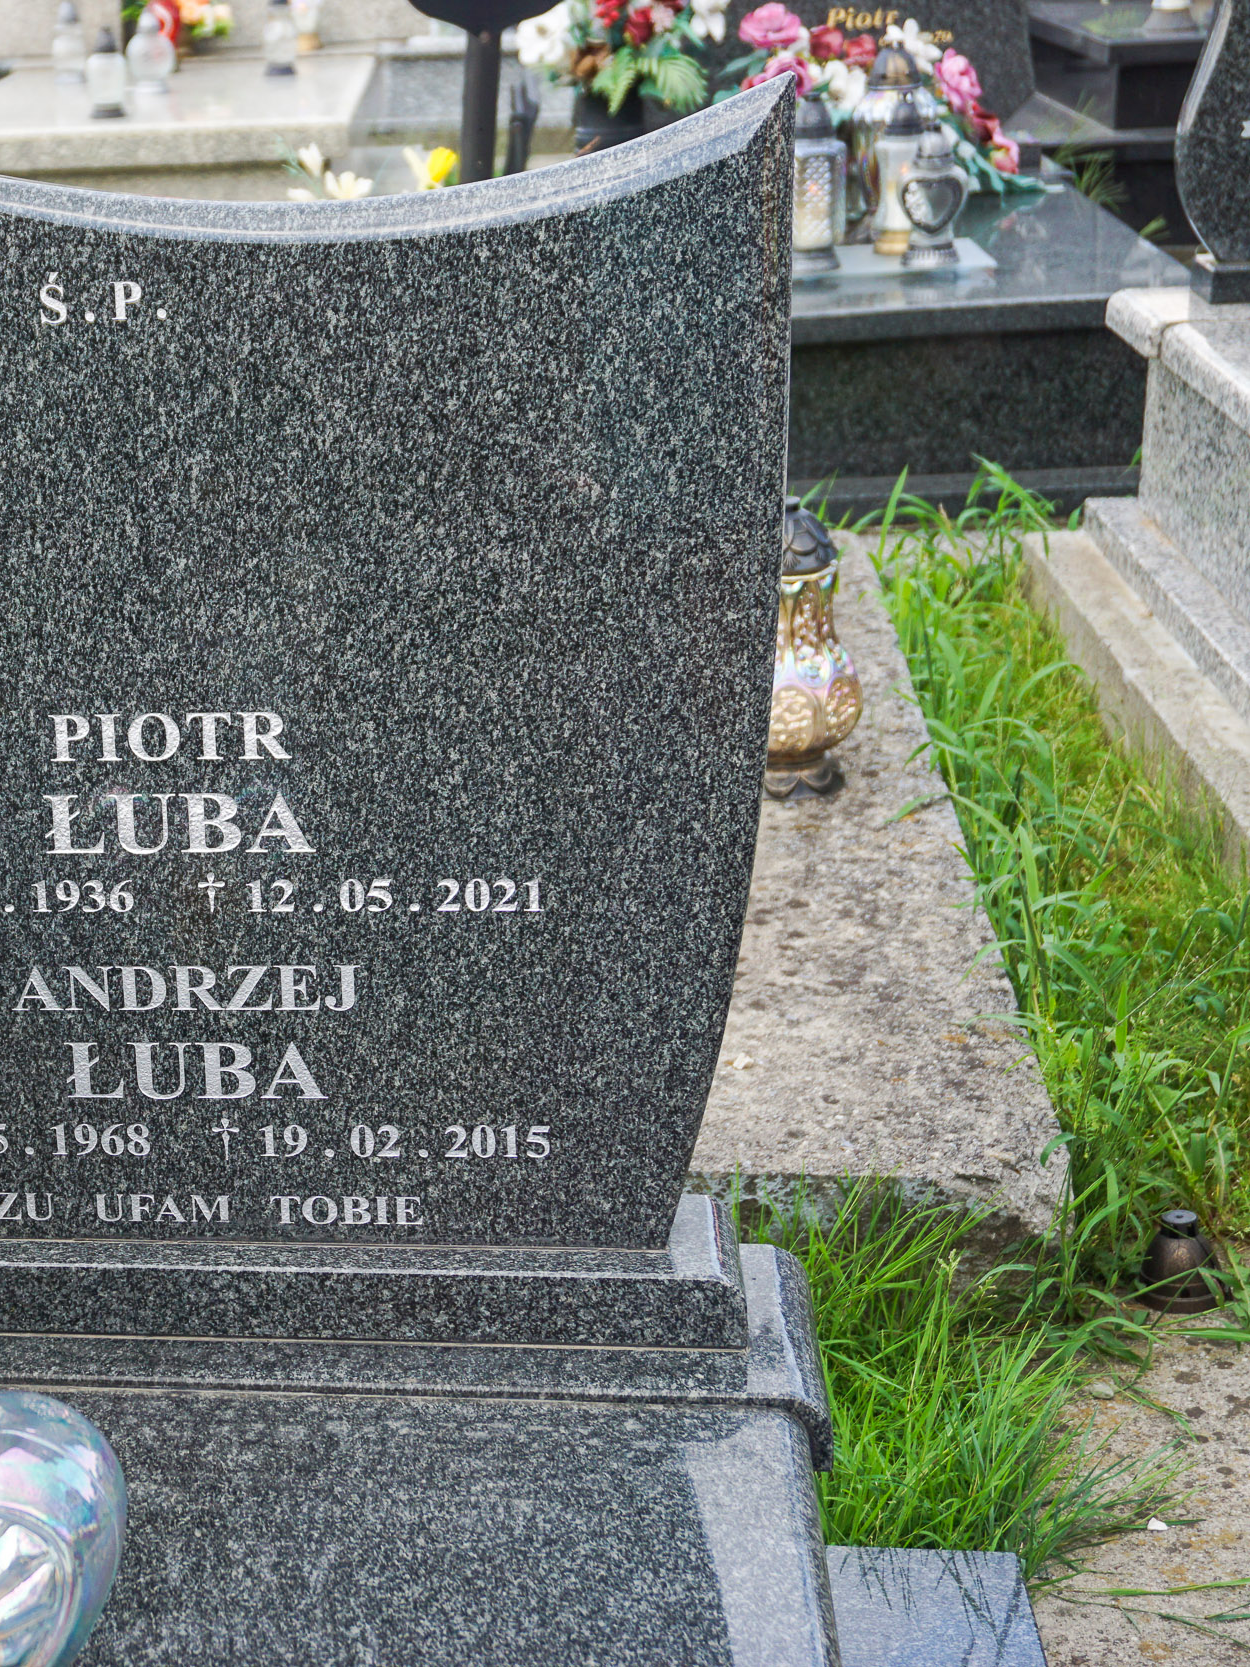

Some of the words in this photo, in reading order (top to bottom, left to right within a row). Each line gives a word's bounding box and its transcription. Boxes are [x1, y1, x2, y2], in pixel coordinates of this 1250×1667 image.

[48, 711, 292, 762] PIOTR
[43, 792, 317, 855] ŁUBA
[12, 964, 361, 1012] ANDRZEJ
[65, 1041, 328, 1101] ŁUBA
[95, 1194, 232, 1223] UFAM
[270, 1196, 425, 1225] TOBIE
